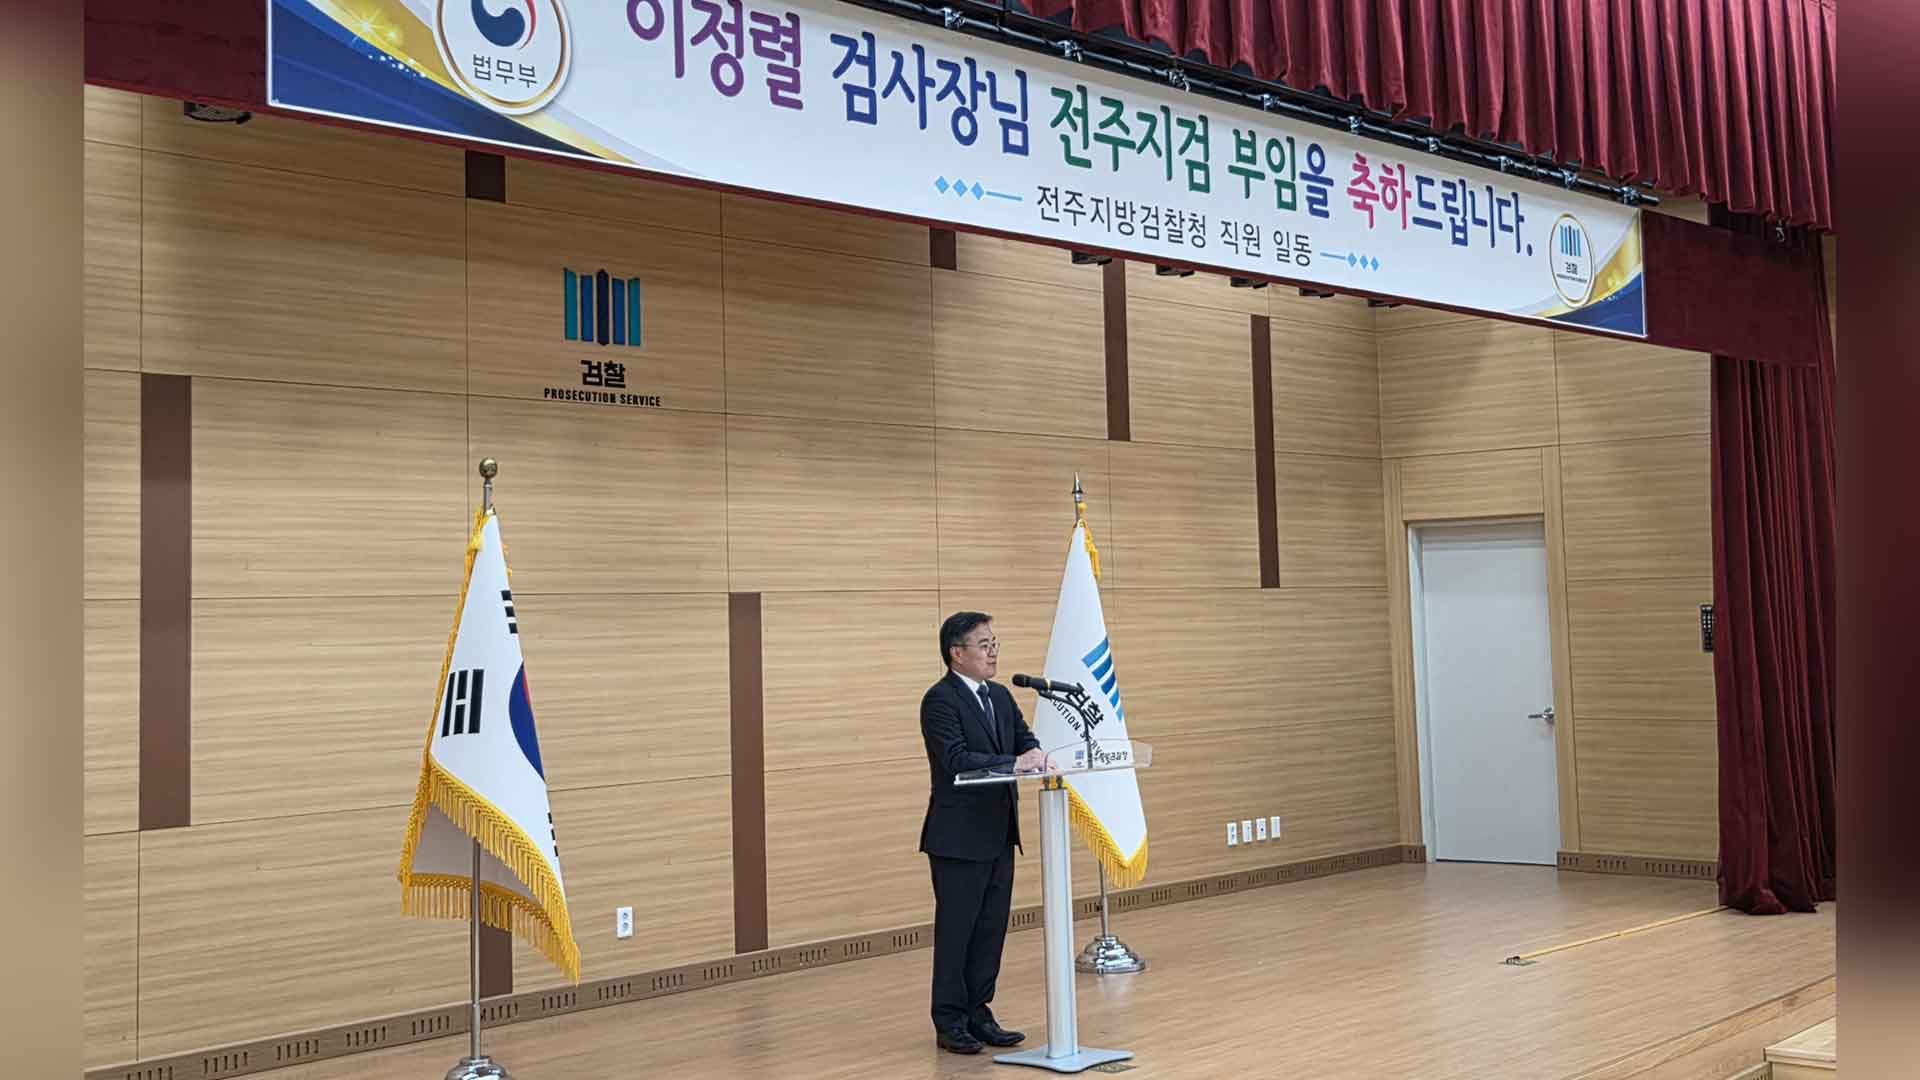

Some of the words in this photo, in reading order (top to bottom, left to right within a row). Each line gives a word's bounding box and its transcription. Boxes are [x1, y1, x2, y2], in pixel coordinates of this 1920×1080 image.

[472, 53, 538, 89] 법무부
[626, 0, 804, 110] 이정렬
[830, 31, 1029, 157] 검사장님
[1050, 85, 1211, 194] 전주지검
[1228, 128, 1334, 218] 부임을
[1346, 151, 1533, 257] 축하드립니다.
[1036, 184, 1208, 249] 전주지방검찰청
[1220, 218, 1262, 258] 직원
[1273, 230, 1313, 268] 일동
[580, 359, 627, 389] 검찰
[543, 387, 617, 404] PROSECUTION
[619, 393, 661, 407] SERVICE
